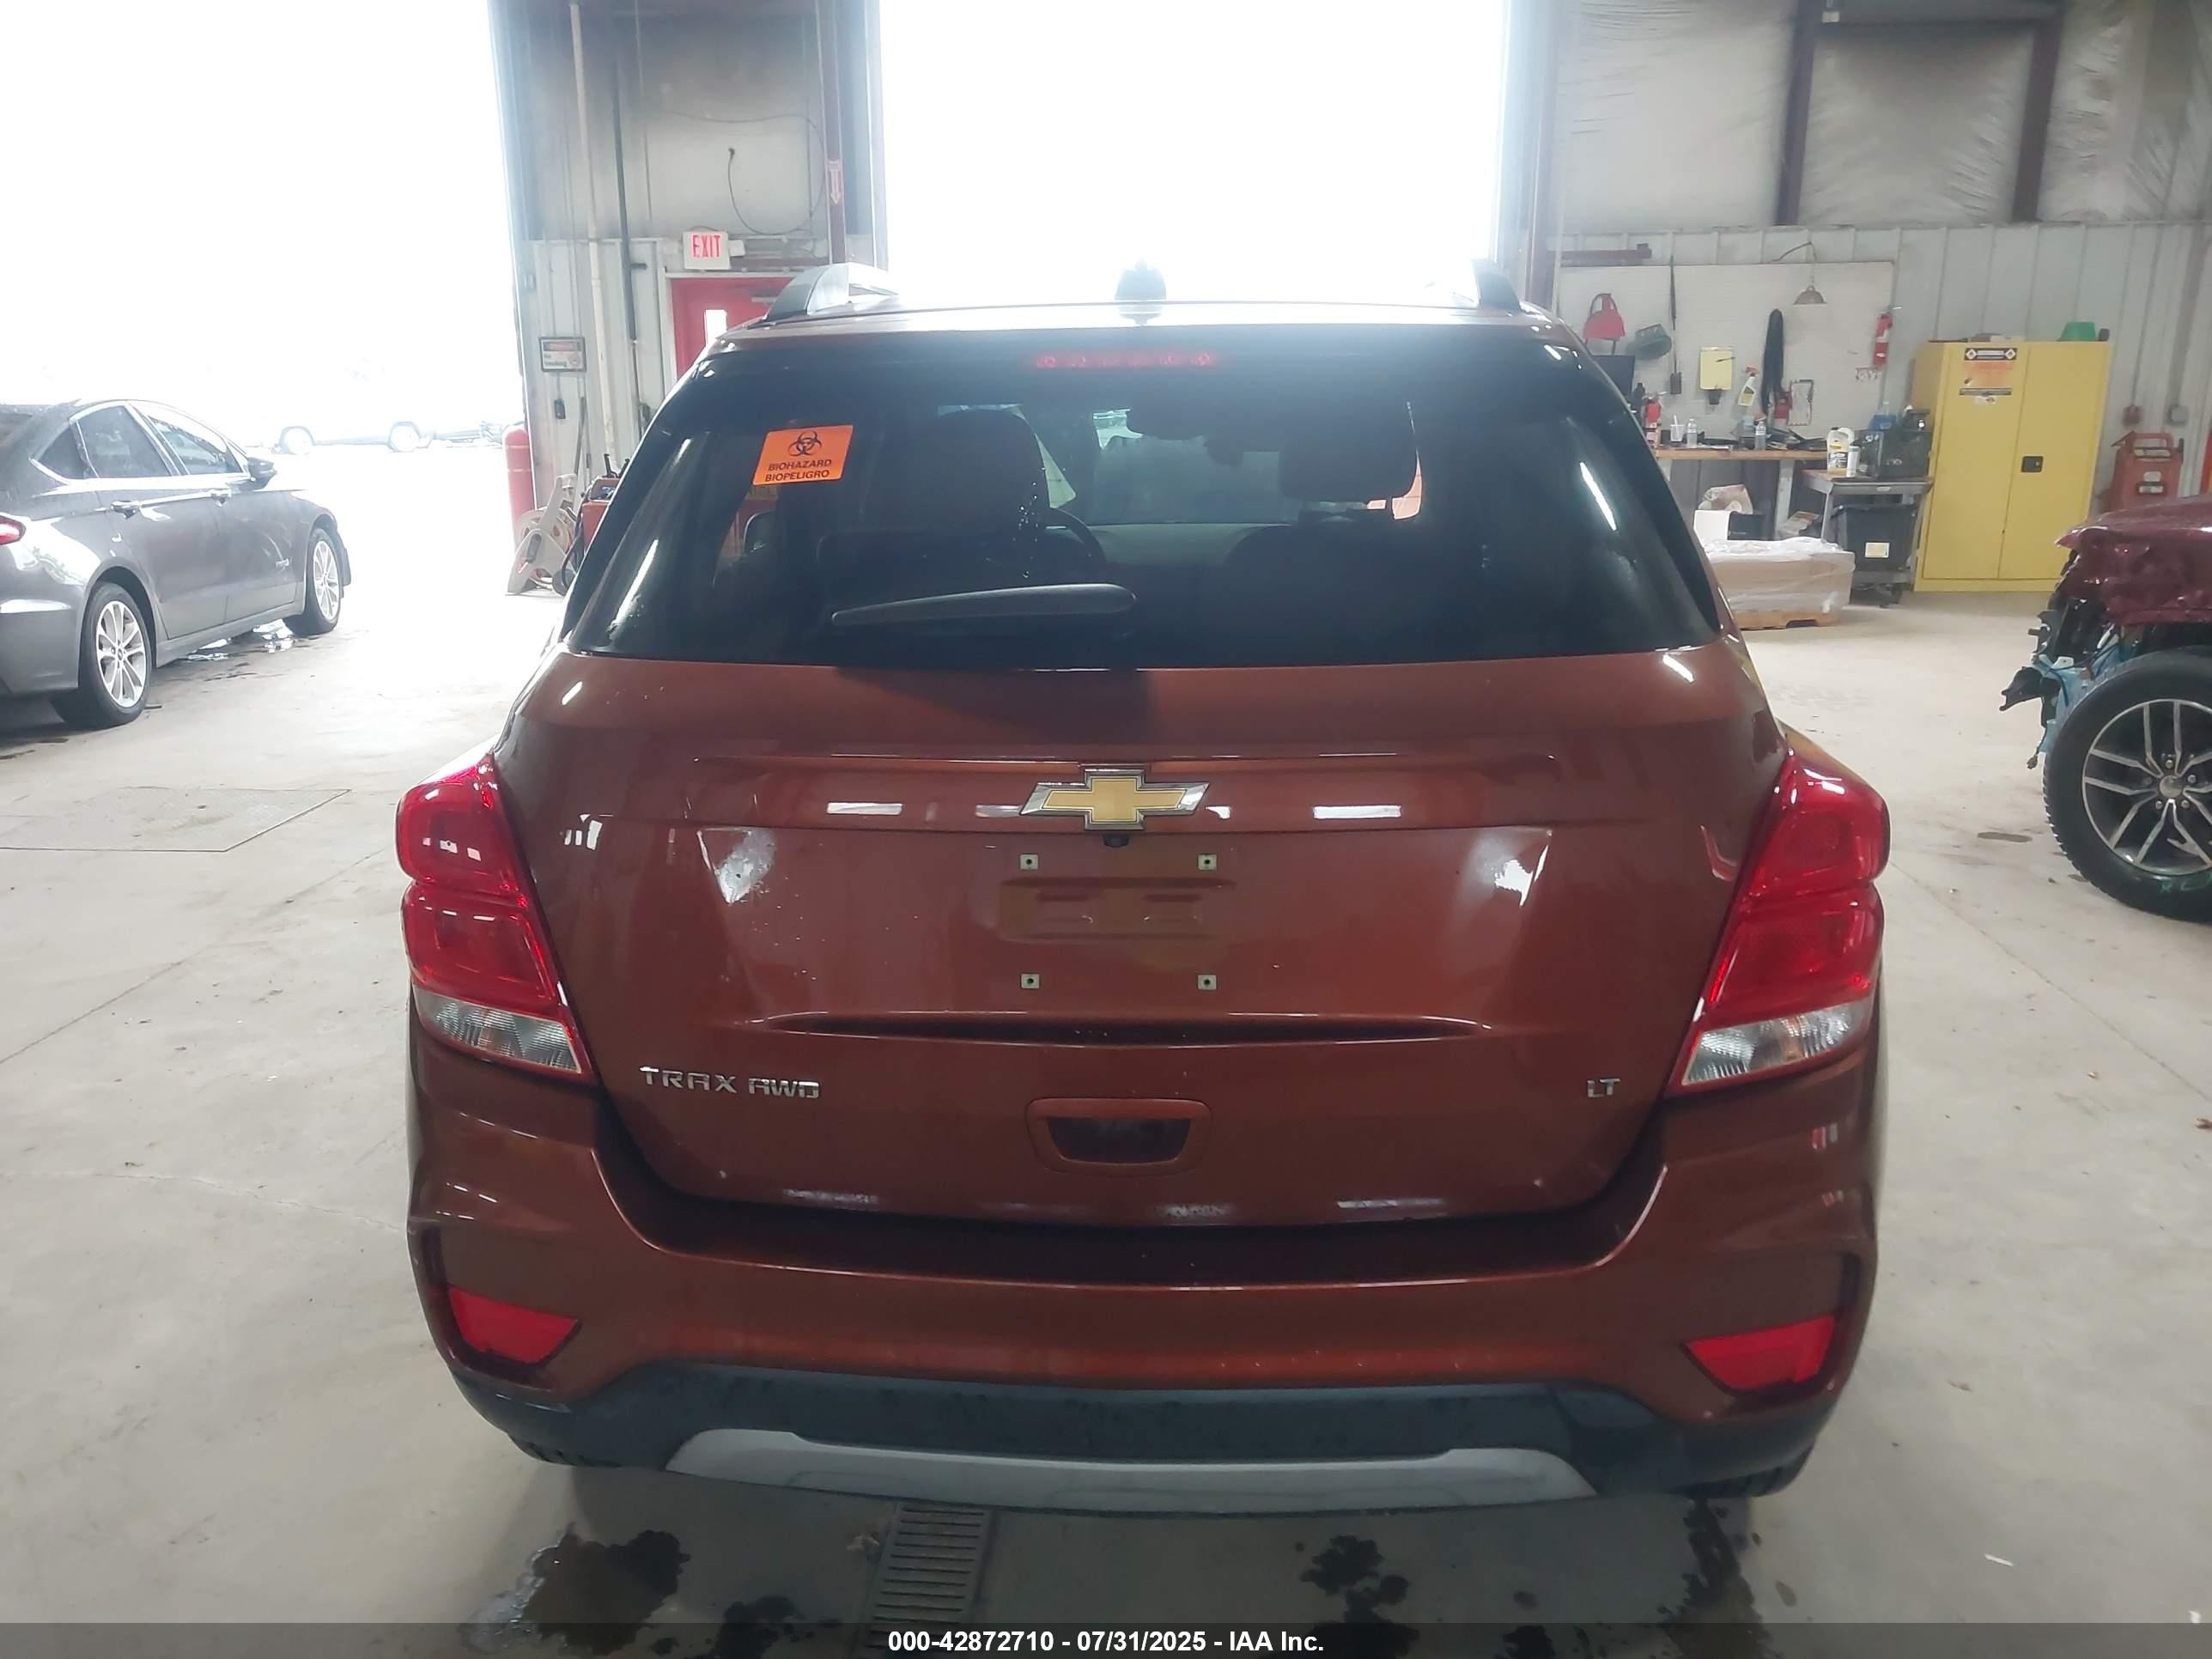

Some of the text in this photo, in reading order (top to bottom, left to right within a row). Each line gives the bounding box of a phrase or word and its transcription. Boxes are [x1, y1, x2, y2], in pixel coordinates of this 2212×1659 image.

[692, 234, 720, 258] EXIT
[768, 459, 832, 471] BIOHAZARD
[764, 470, 830, 482] BIOPELIGRO
[640, 1066, 818, 1098] TRAX AWD
[1586, 1078, 1621, 1098] LT
